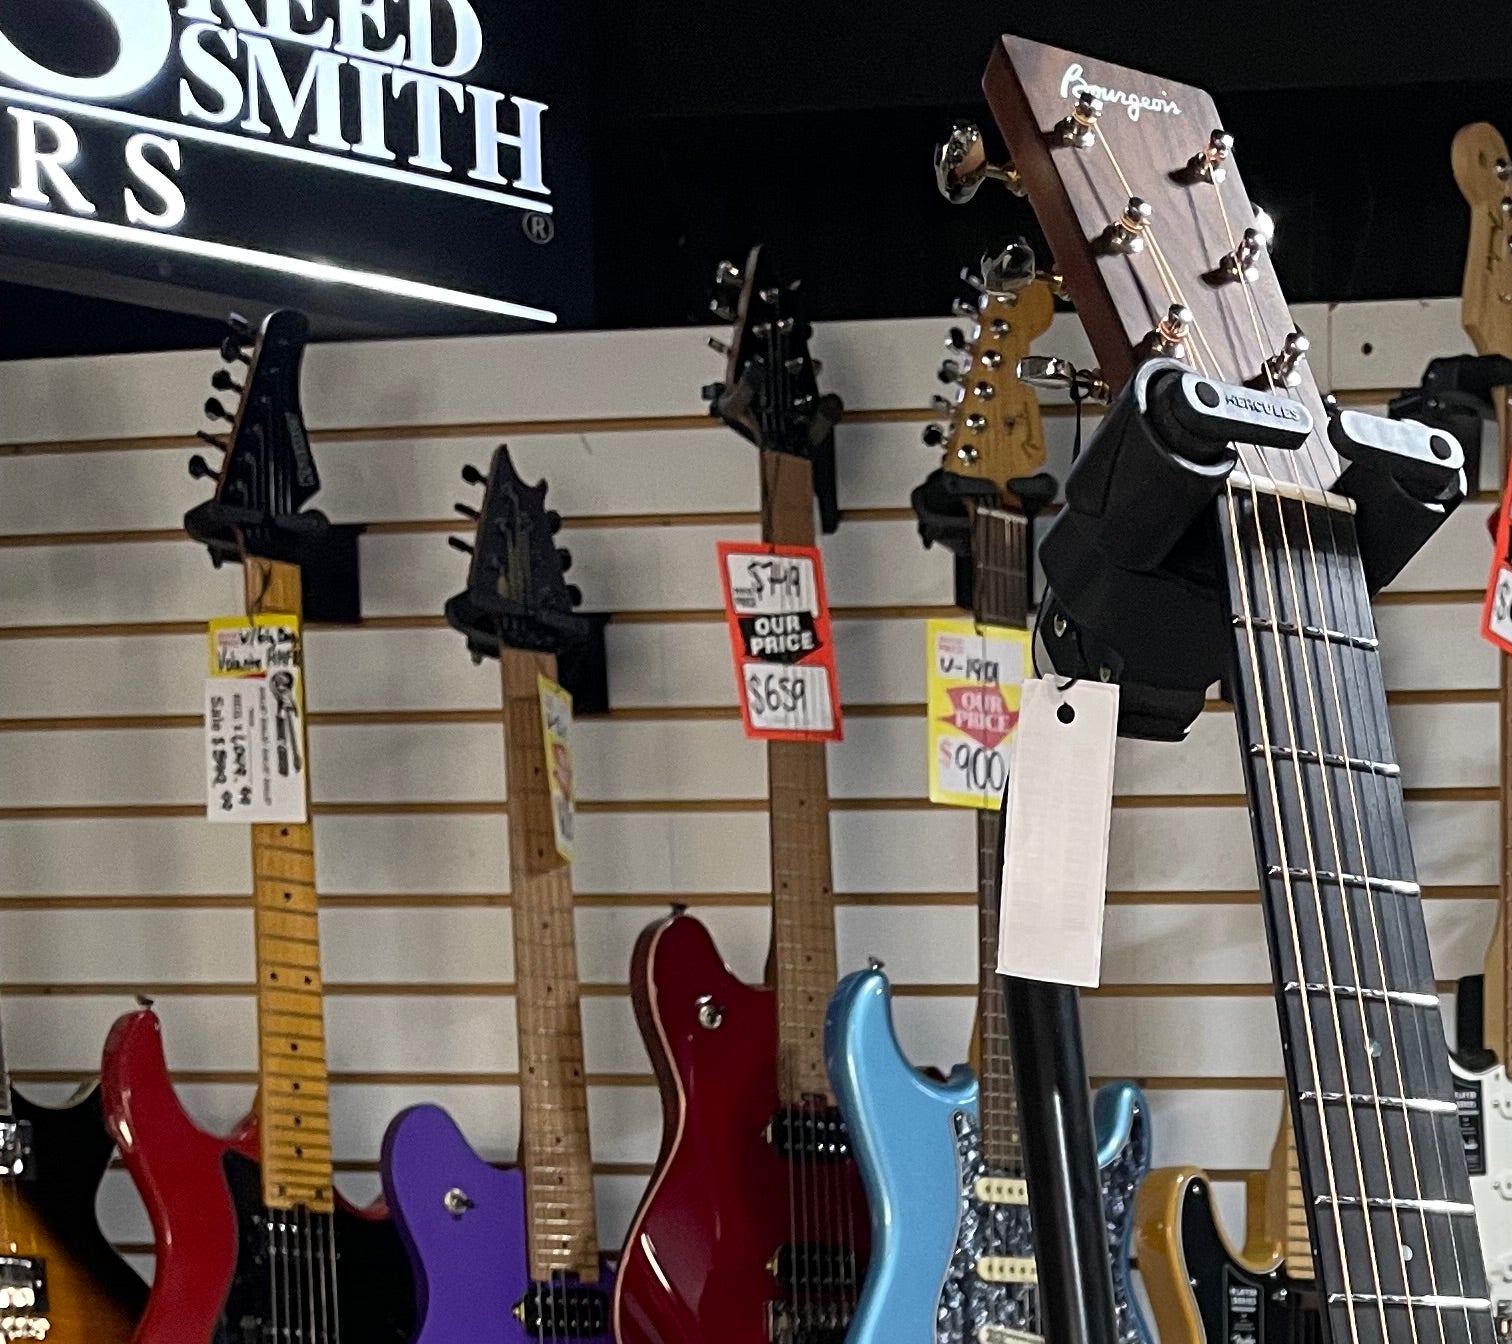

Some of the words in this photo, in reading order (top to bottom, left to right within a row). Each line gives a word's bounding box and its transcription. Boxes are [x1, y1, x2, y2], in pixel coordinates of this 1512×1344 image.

[1059, 62, 1183, 122] Bourgeois
[178, 20, 551, 195] SMITH
[1226, 393, 1300, 423] HERCULES
[753, 614, 801, 637] OUR
[750, 630, 816, 656] PRICE
[960, 691, 1004, 714] OUR
[954, 711, 1011, 733] PRICE
